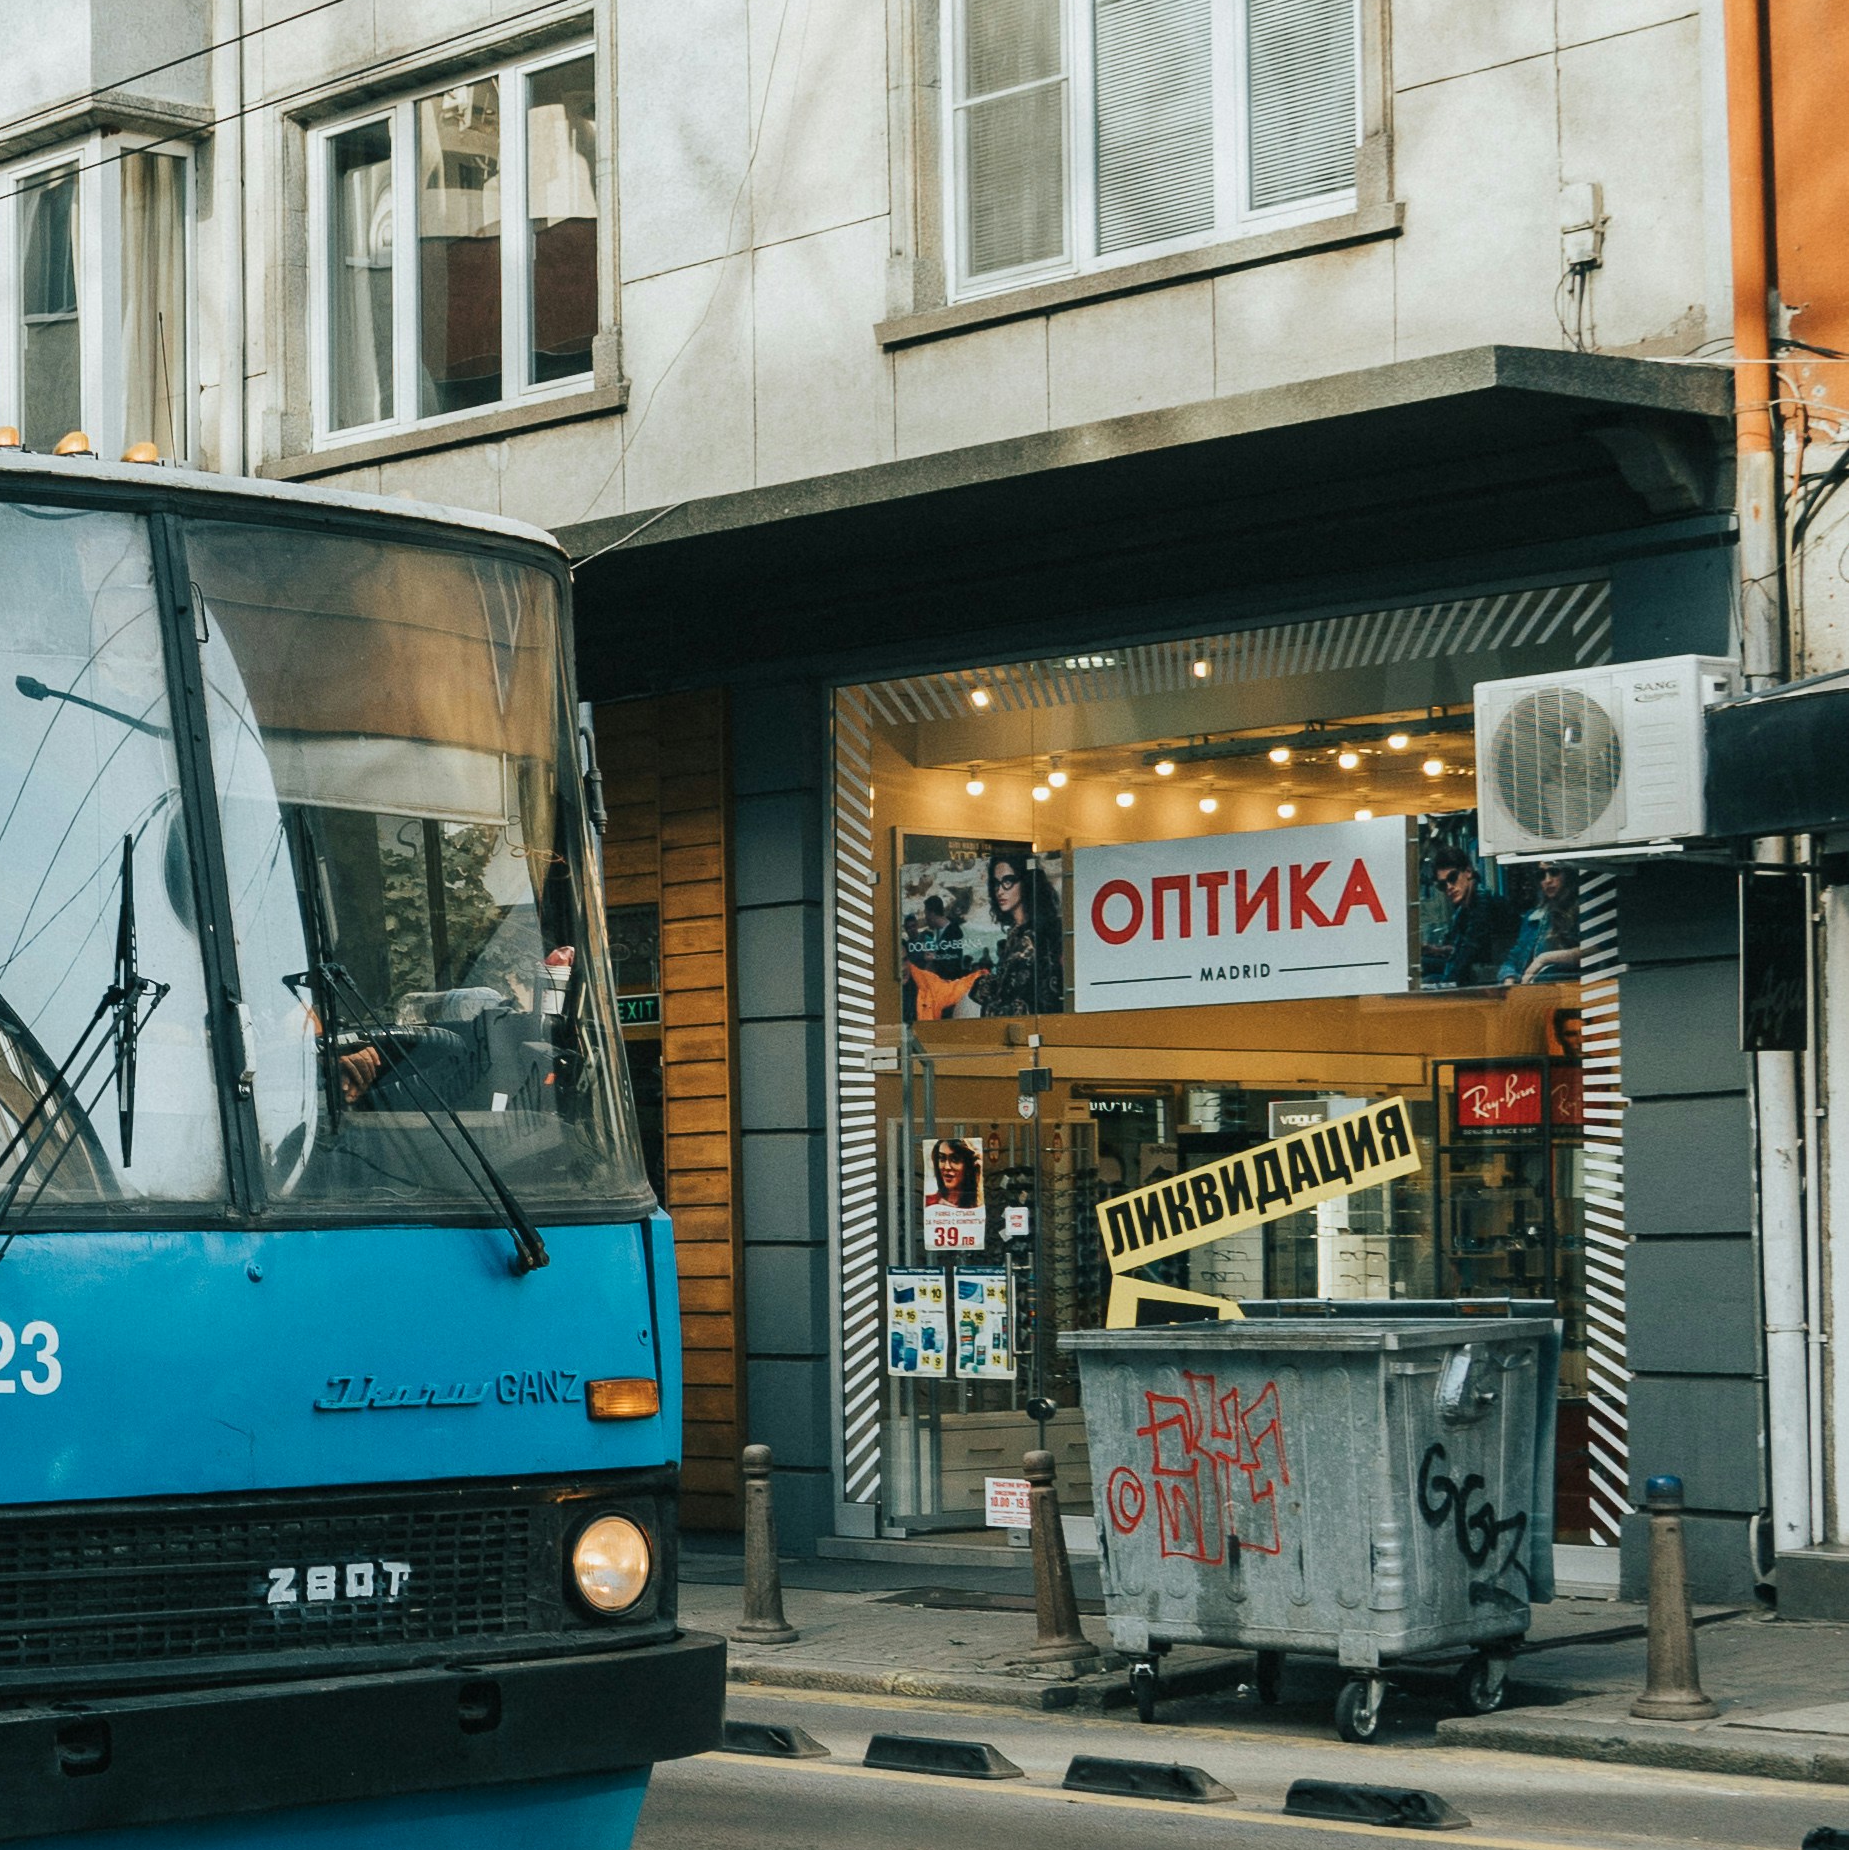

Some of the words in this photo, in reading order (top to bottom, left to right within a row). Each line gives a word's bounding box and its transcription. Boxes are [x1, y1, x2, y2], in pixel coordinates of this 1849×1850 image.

[1090, 857, 1388, 946] ОПТИКА
[1199, 962, 1272, 983] MADRID
[617, 1000, 655, 1021] EXIT
[1279, 1113, 1323, 1127] VOGUE
[1105, 1103, 1411, 1258] ЛИКВИДАЦИЯ
[934, 1226, 959, 1247] 39
[495, 1369, 585, 1405] GANZ
